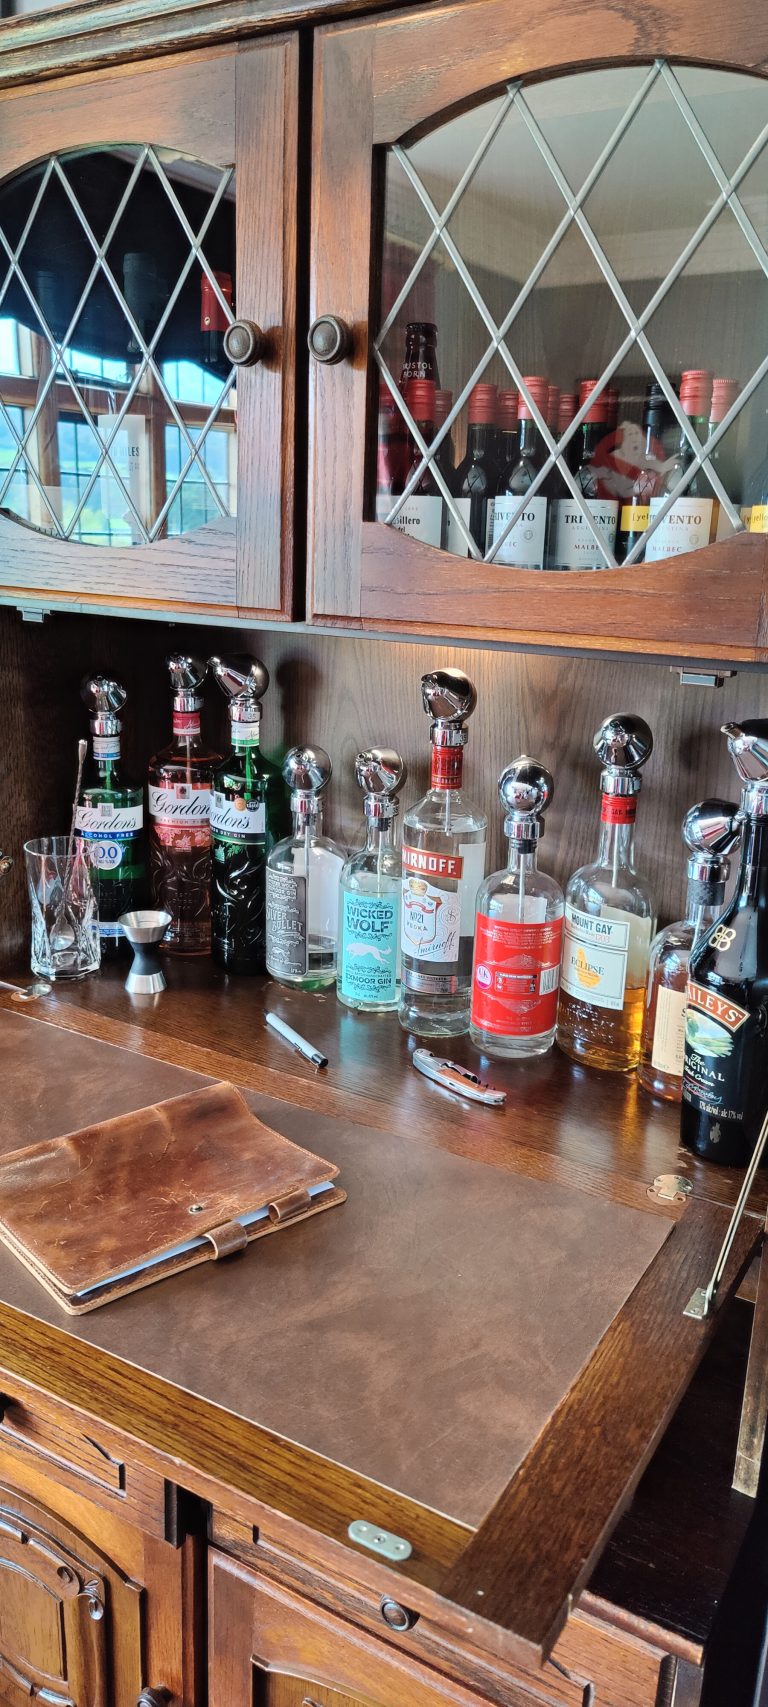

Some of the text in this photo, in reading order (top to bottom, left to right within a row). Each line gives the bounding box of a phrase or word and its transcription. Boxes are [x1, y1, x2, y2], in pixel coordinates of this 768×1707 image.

[565, 514, 616, 525] TRIENTO
[649, 514, 702, 525] TRVENTO
[77, 809, 136, 830] Gordon's
[80, 831, 113, 839] ALCOHOL
[402, 847, 456, 875] MIRNOFF
[347, 905, 393, 920] WICKED
[347, 916, 390, 933] WOLF
[571, 912, 594, 931] MOUNT
[595, 922, 613, 936] GAY
[571, 956, 605, 976] ECLIPSE
[688, 982, 735, 1022] AILEYS
[685, 1054, 725, 1082] RIGINAL
